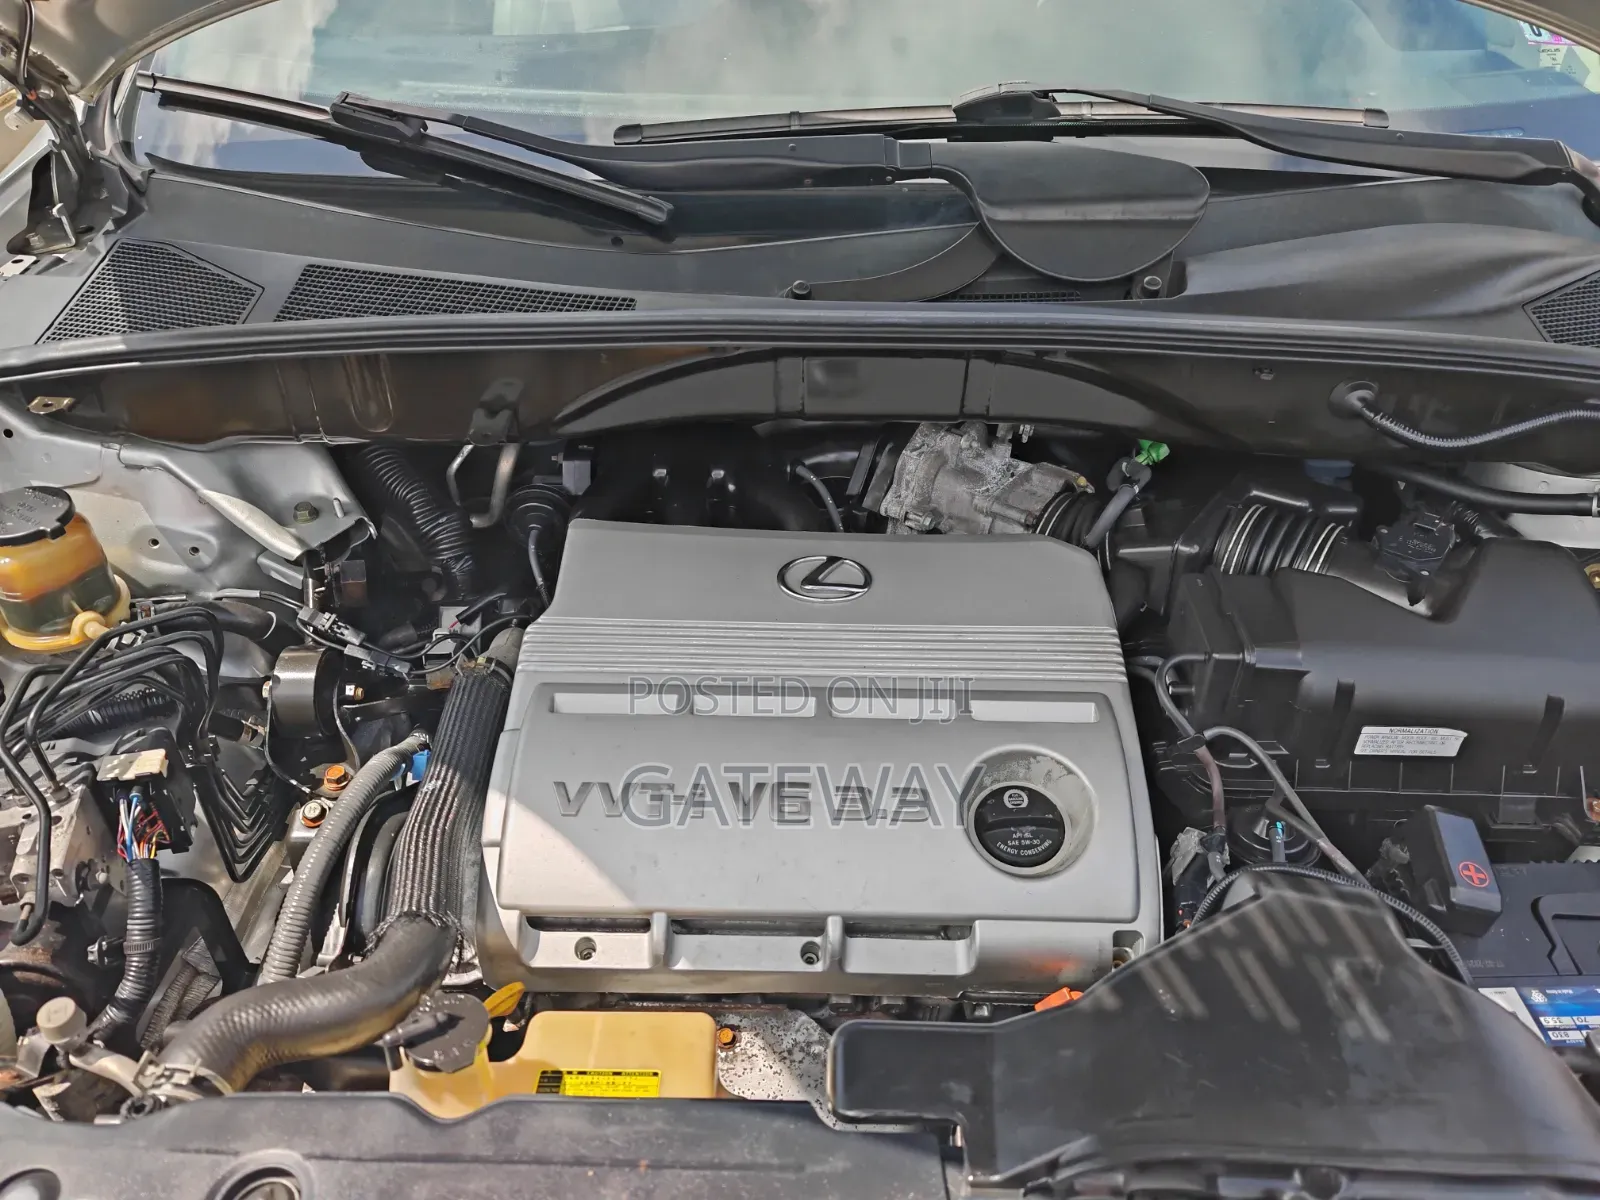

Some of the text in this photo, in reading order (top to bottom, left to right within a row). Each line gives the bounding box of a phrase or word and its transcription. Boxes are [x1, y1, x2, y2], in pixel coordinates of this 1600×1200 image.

[727, 782, 812, 823] V6
[833, 784, 931, 823] 3.3
[996, 839, 1052, 856] ENERGY CONSERVING
